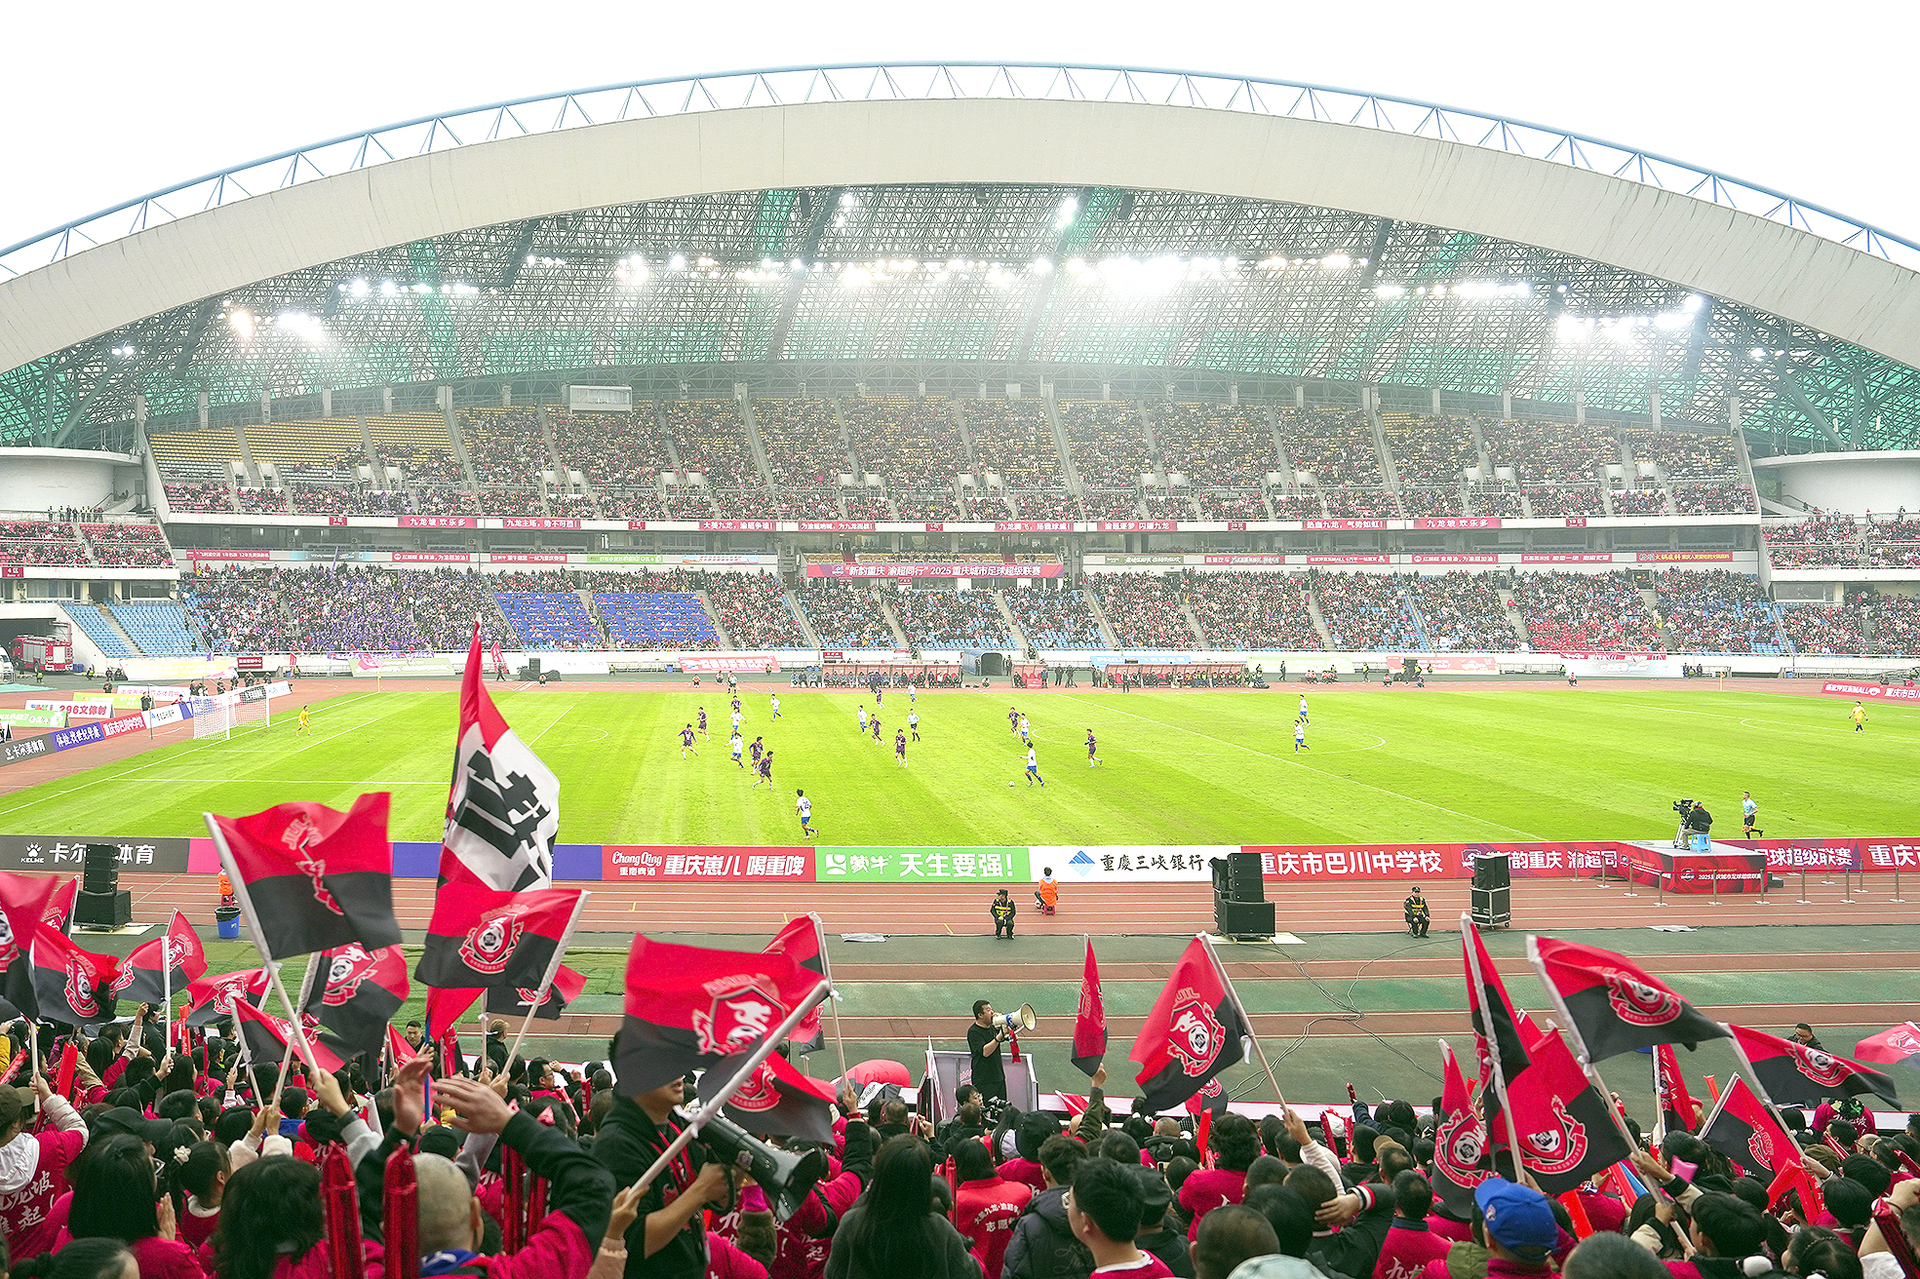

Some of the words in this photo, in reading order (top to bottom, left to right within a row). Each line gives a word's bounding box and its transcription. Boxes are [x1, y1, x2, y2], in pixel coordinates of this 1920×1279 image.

[440, 518, 466, 526] 欢乐多
[1459, 519, 1489, 528] 欢乐多
[49, 843, 155, 865] 卡尔体育
[663, 854, 741, 876] 重庆崽儿
[745, 855, 805, 876] 喝重啤
[850, 854, 892, 875] 蒙牛
[898, 853, 1014, 877] 天生要强！
[1262, 850, 1443, 875] 重庆市巴川中学校
[1868, 842, 1920, 867] 重庆
